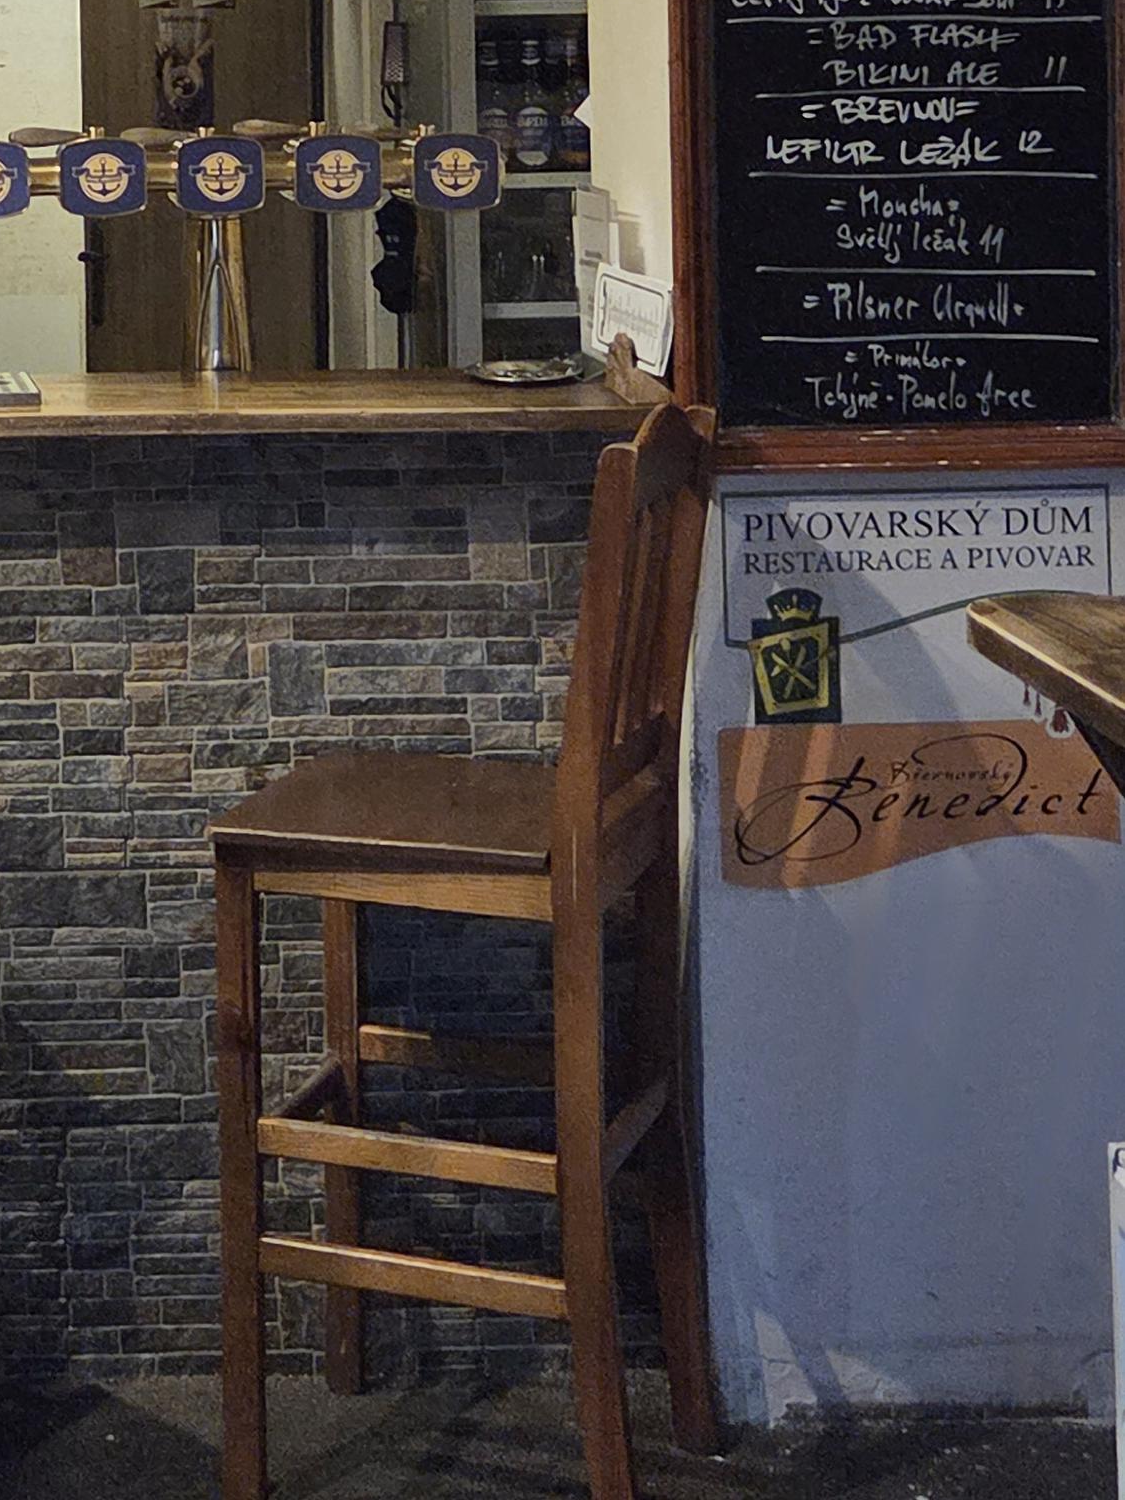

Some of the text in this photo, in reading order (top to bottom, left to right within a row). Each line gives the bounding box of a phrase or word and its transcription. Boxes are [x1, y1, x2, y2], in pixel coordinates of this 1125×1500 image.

[823, 59, 929, 87] BIKINI
[947, 60, 1001, 86] ALE
[900, 127, 1002, 170] LEŽÁK
[1018, 130, 1056, 154] 12
[979, 224, 1005, 264] 11
[976, 369, 1037, 417] free
[743, 498, 1092, 542] PIVOVARSKÝ DŮM
[743, 545, 1095, 575] RESTAURACE A PIVOVAR
[734, 733, 1102, 865] Benedict
